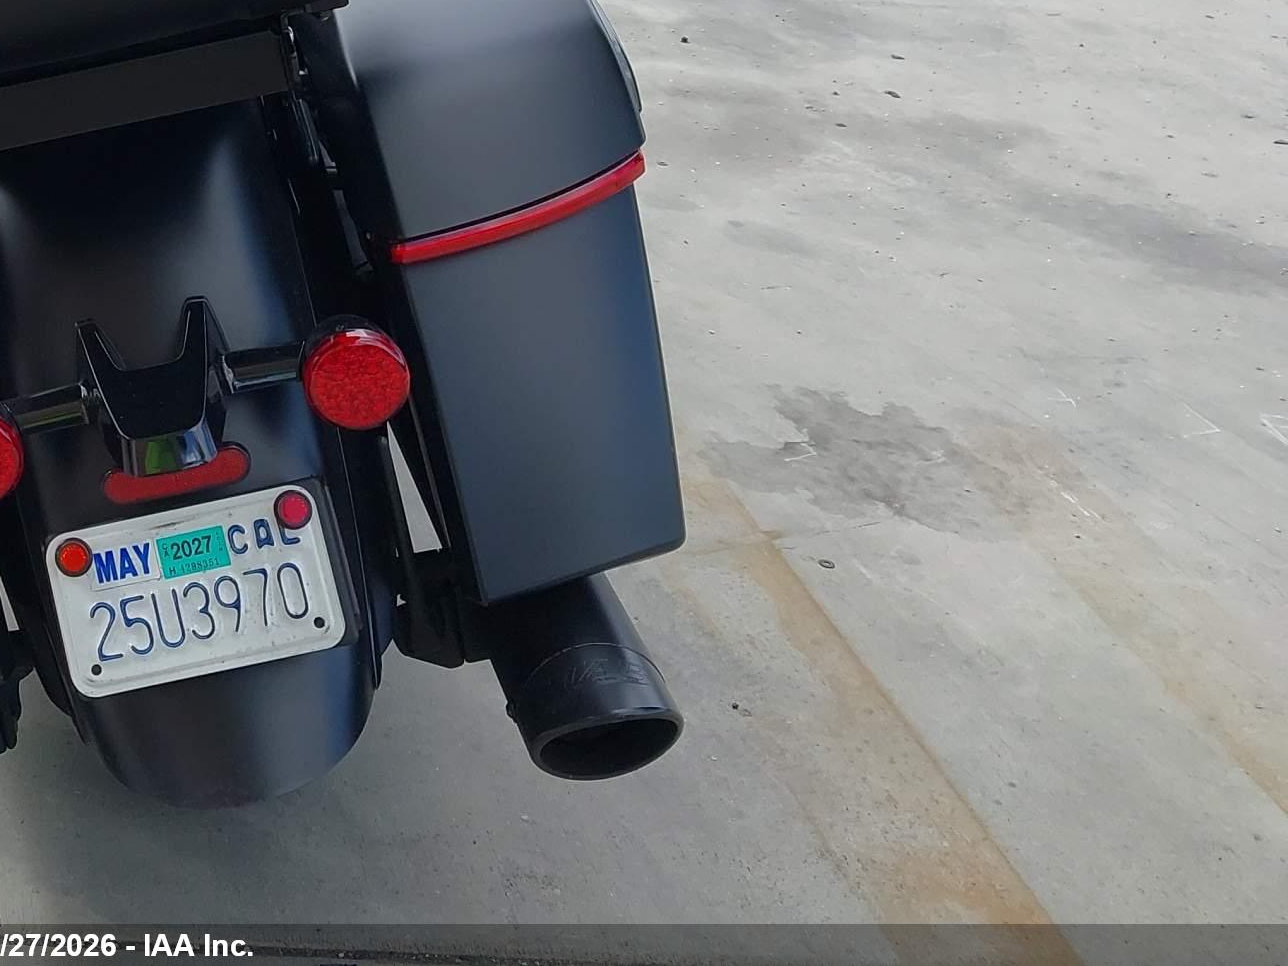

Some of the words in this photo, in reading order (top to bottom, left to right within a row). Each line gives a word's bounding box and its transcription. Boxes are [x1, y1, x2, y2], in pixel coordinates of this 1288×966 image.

[93, 542, 150, 583] MAY
[170, 535, 212, 560] 2027
[89, 561, 310, 663] 25U3970
